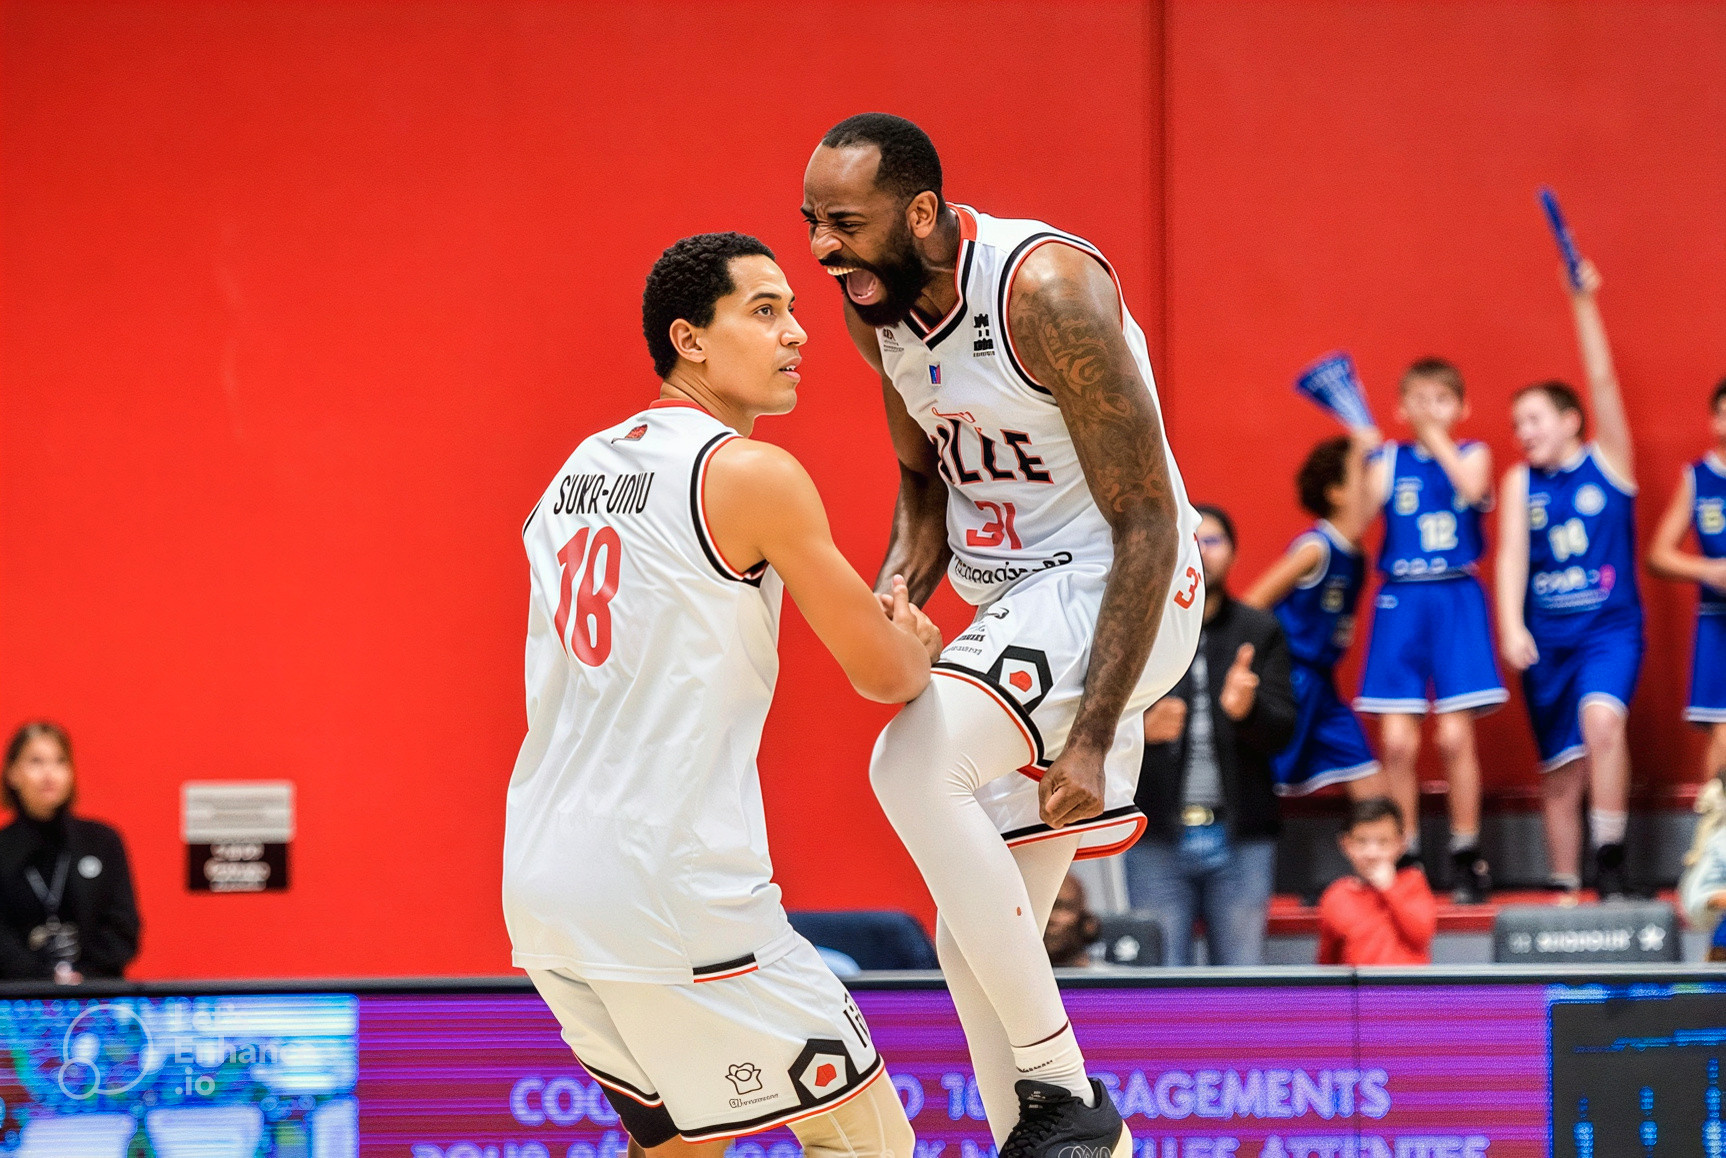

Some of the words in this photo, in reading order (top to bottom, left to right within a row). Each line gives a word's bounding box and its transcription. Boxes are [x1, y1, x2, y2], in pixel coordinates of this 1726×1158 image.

[966, 500, 1023, 550] 31
[1417, 511, 1458, 552] 12
[554, 525, 622, 667] 18
[1173, 566, 1203, 610] 3
